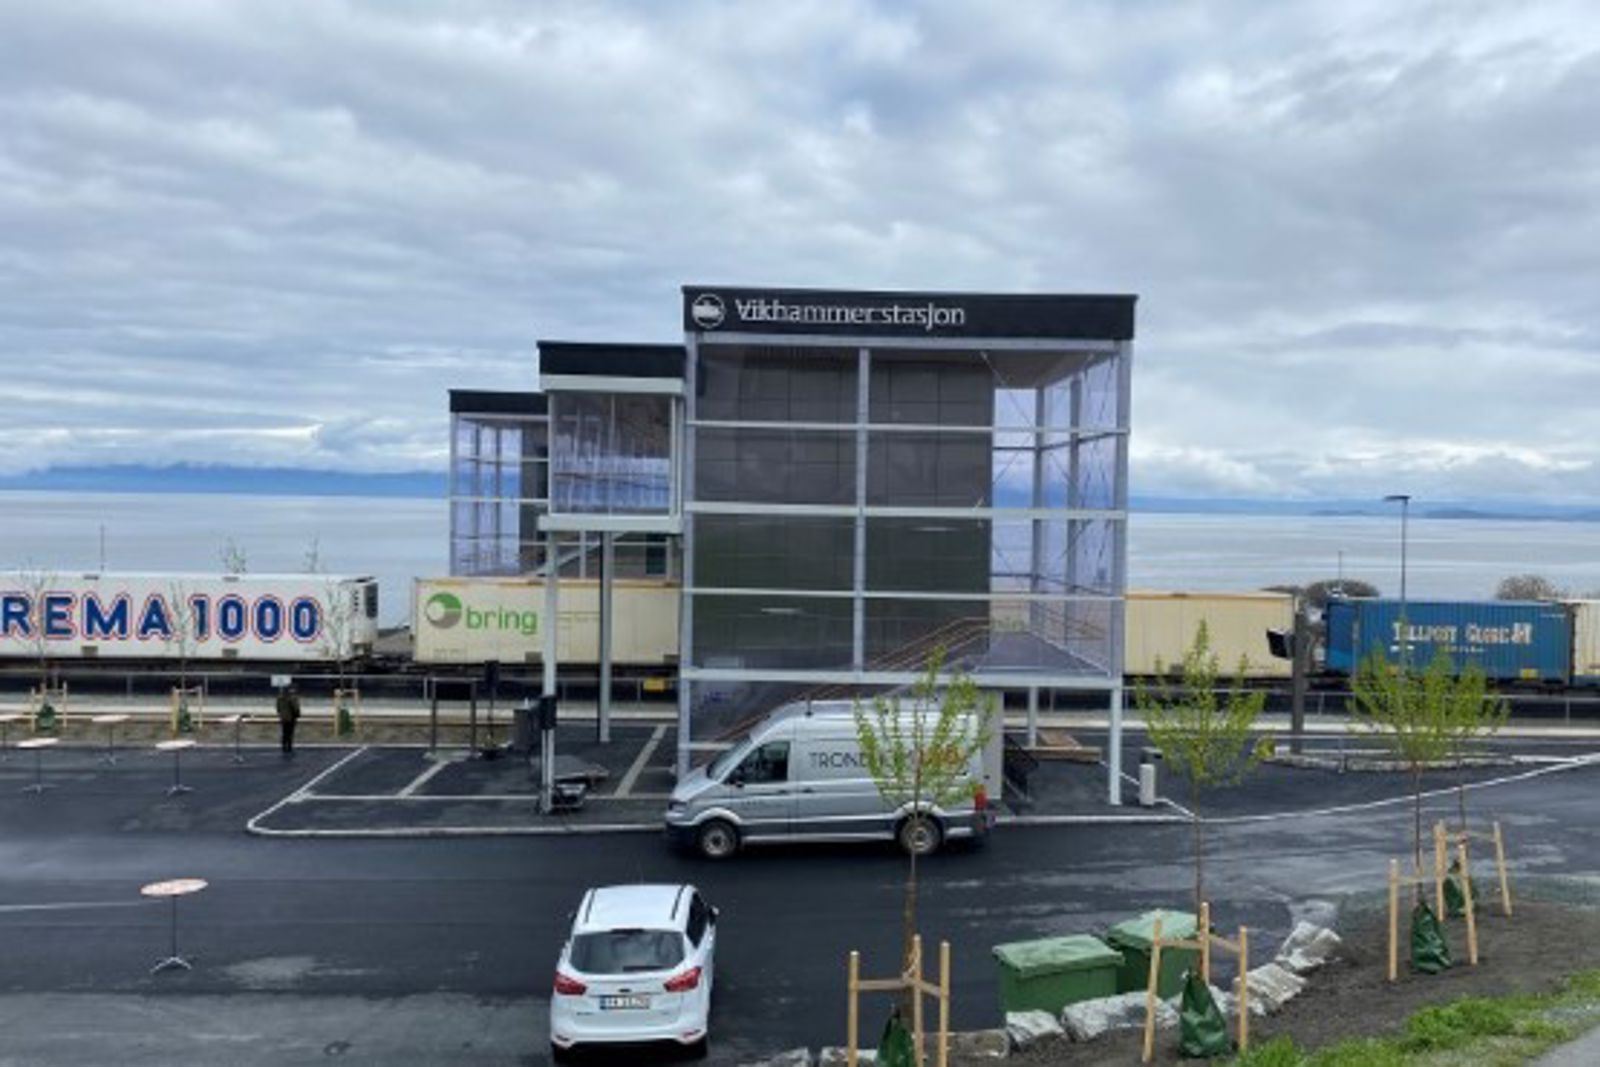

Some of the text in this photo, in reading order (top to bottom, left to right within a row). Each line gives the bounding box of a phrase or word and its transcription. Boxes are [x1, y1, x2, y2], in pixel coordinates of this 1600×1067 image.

[735, 299, 965, 330] Vikhammer stasjon
[0, 591, 323, 643] REMA 1000
[466, 606, 537, 635] bring
